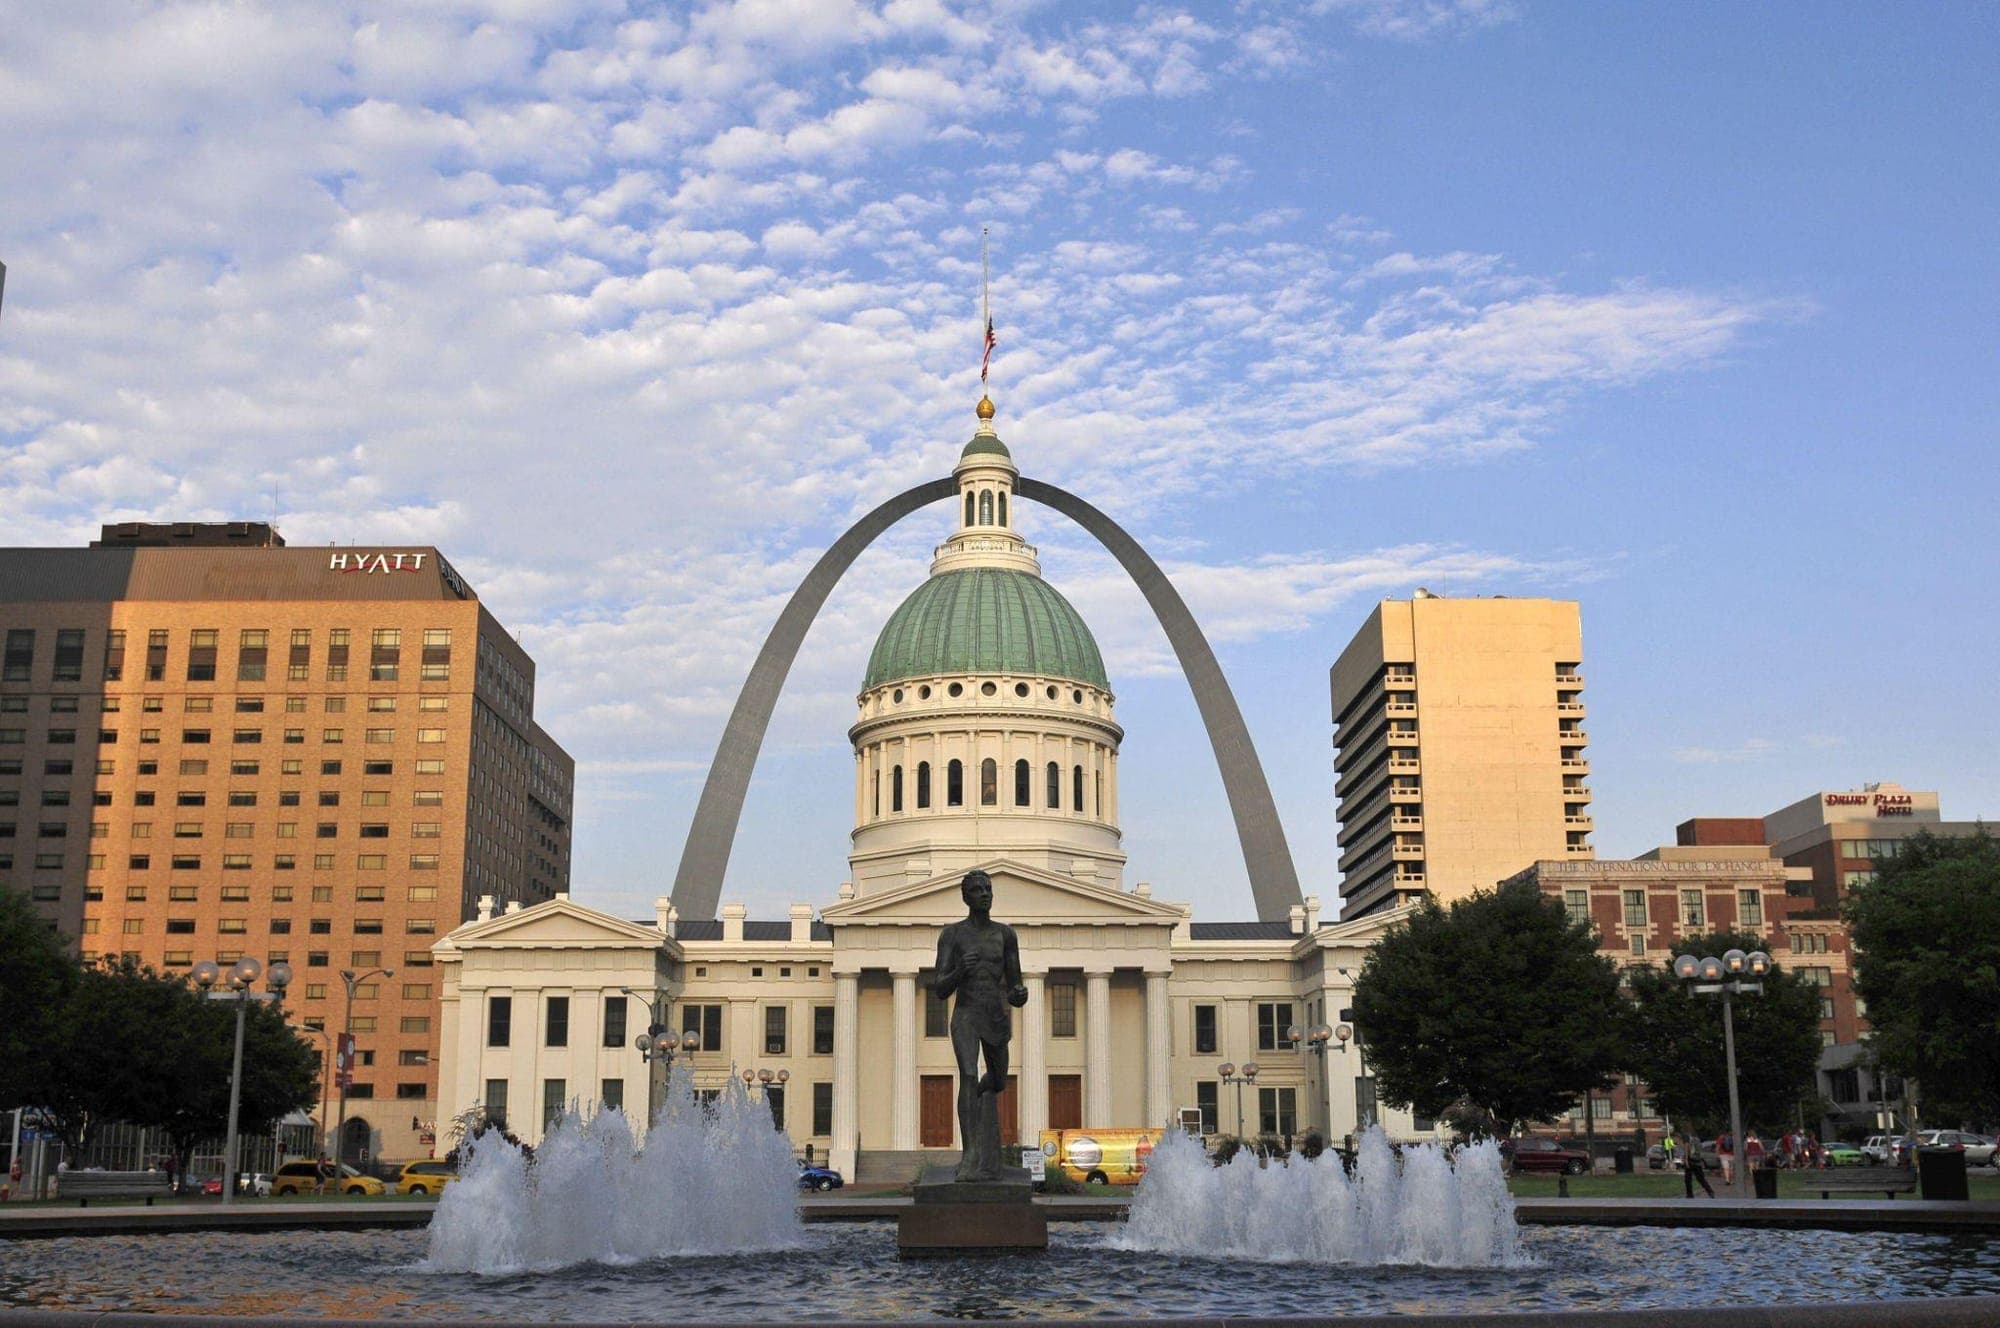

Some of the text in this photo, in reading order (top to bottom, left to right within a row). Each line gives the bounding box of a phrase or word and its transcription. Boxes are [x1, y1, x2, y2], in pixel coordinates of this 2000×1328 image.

[329, 553, 427, 574] HYATT
[1825, 794, 1912, 806] DRURY PLAZA
[1877, 805, 1913, 818] HOTEL
[1558, 861, 1764, 872] THE INTERNATIONAL FUR EXCHANGE
